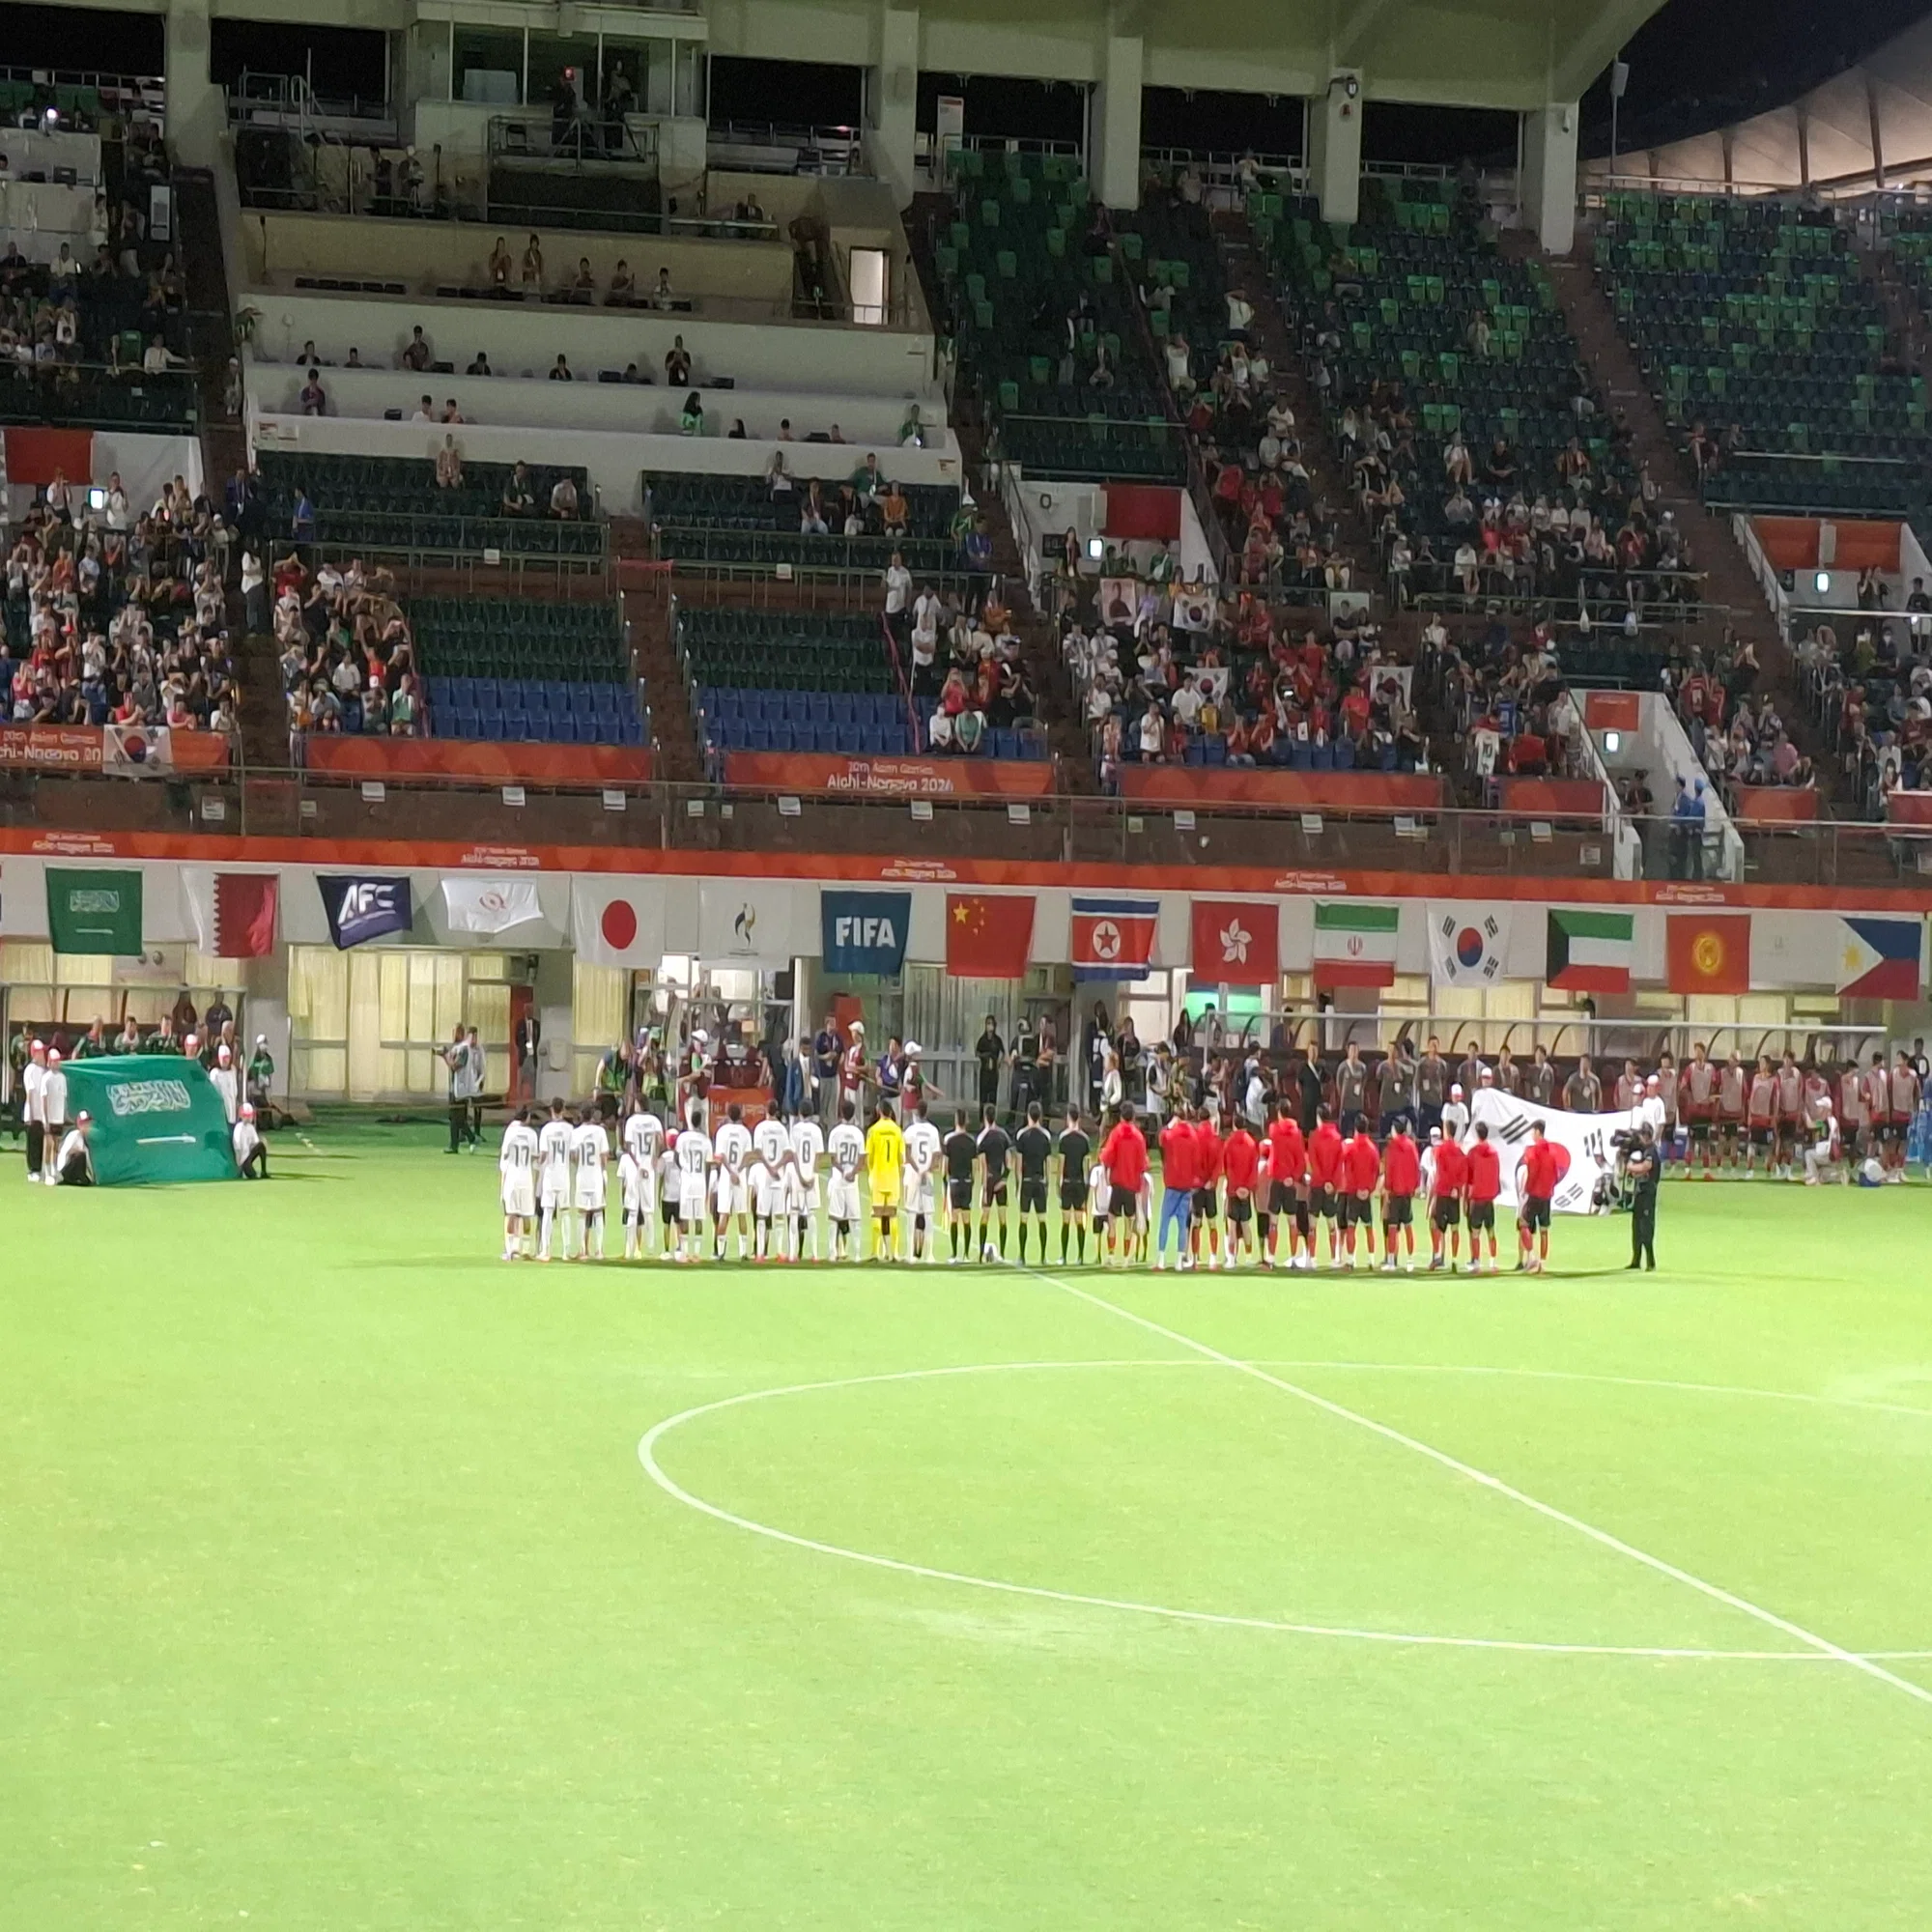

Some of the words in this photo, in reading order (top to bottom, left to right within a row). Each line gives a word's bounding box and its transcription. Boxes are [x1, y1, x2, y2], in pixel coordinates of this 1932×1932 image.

[337, 883, 395, 924] AFC
[836, 916, 896, 949] FIFA
[514, 1144, 529, 1168] 17
[552, 1140, 565, 1164] 14
[580, 1142, 595, 1167] 12
[729, 1141, 739, 1164] 6
[768, 1139, 778, 1162] 3
[839, 1142, 858, 1165] 20
[918, 1141, 928, 1164] 5
